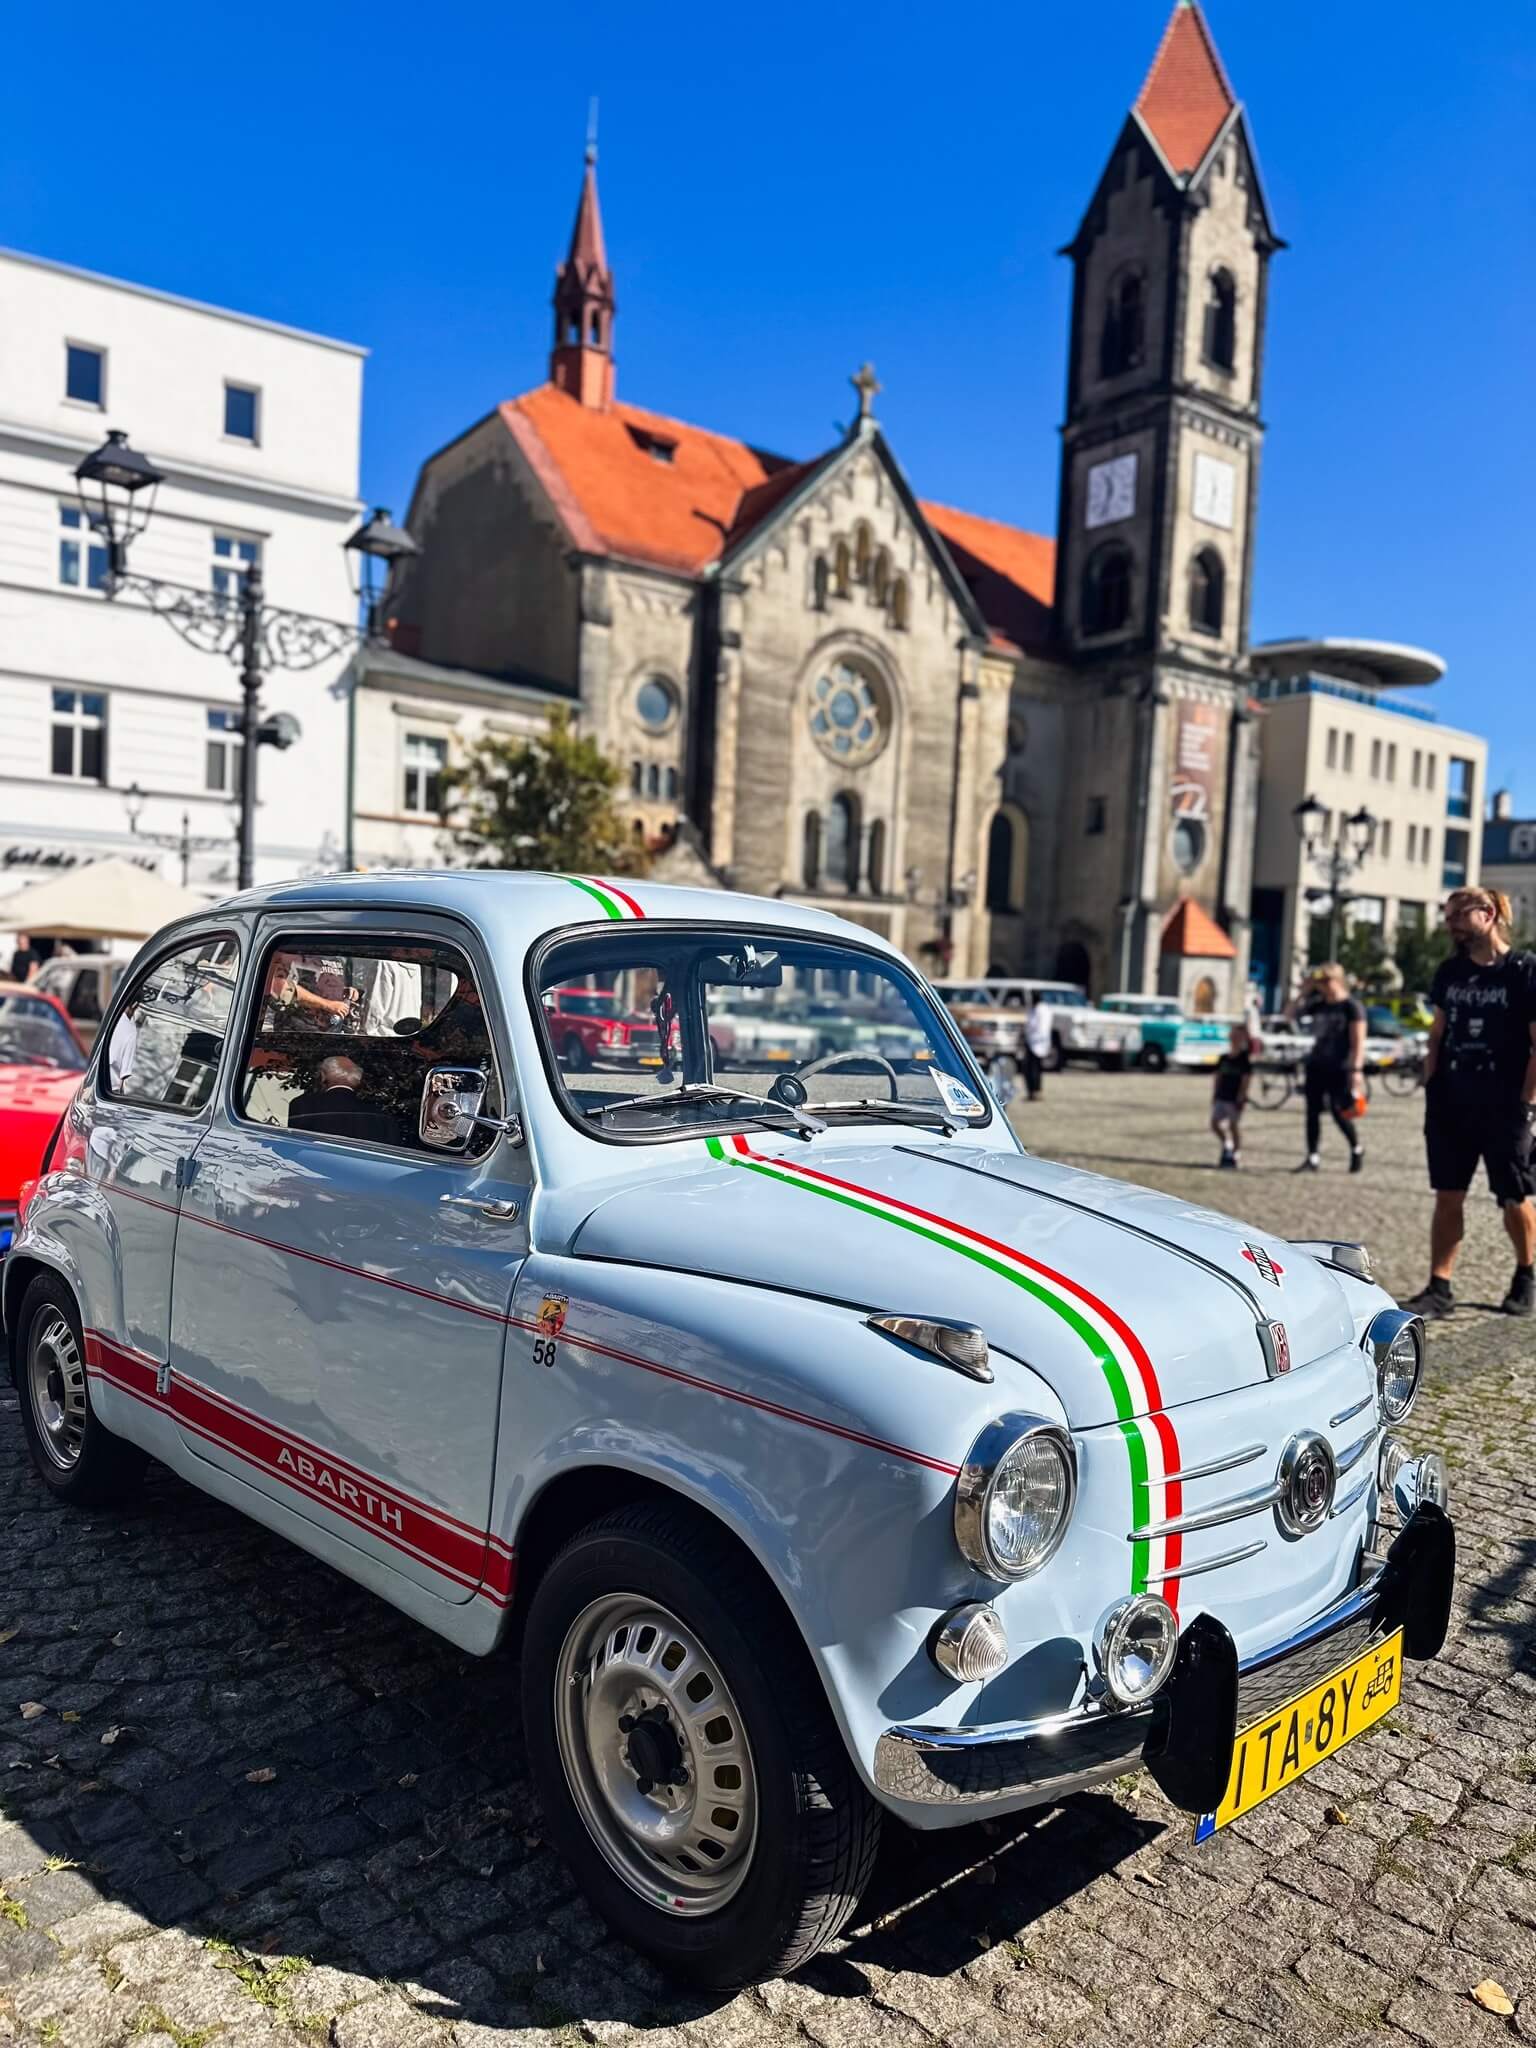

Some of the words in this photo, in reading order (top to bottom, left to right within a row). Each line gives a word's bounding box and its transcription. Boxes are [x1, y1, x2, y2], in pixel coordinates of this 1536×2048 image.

[532, 1339, 557, 1368] 58
[276, 1447, 403, 1532] ABARTH
[1315, 1670, 1359, 1753] 8Y
